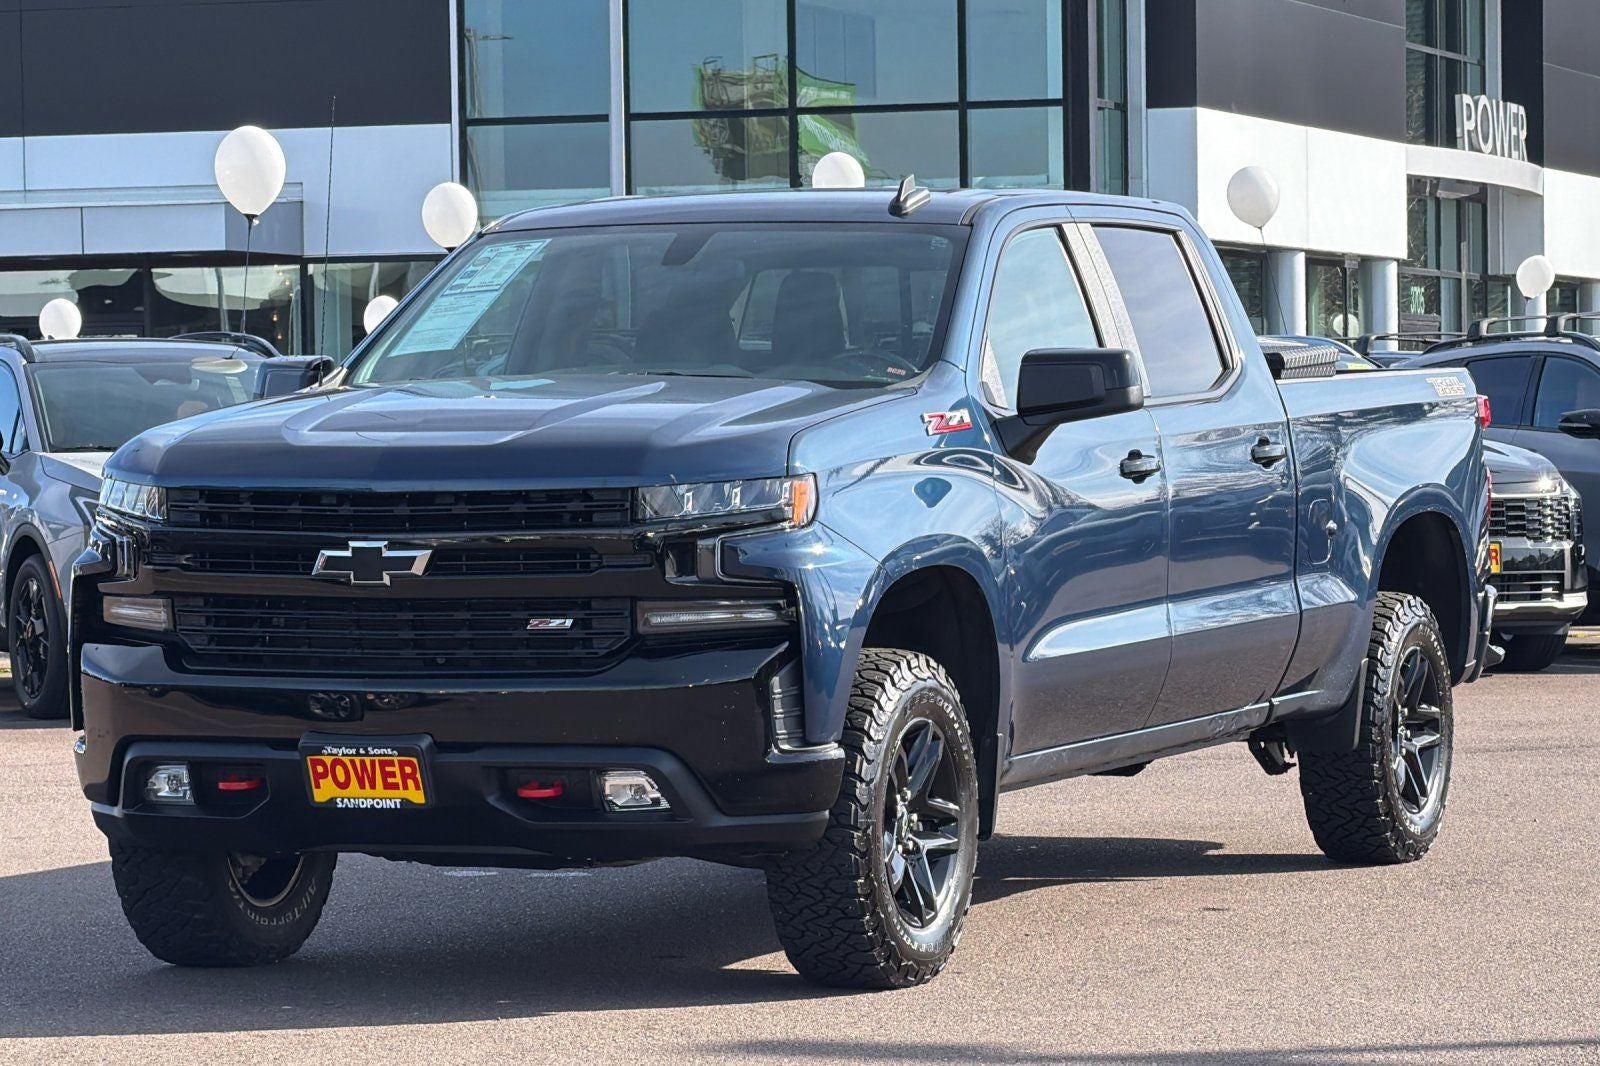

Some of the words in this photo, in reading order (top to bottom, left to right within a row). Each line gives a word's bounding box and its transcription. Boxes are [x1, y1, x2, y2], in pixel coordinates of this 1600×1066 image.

[1456, 93, 1528, 162] POWER
[920, 408, 973, 436] Z71
[526, 618, 574, 630] Z71
[323, 745, 357, 757] Taylor
[367, 746, 392, 755] Sons
[308, 757, 422, 791] POWER
[336, 797, 402, 809] SANDPOINT
